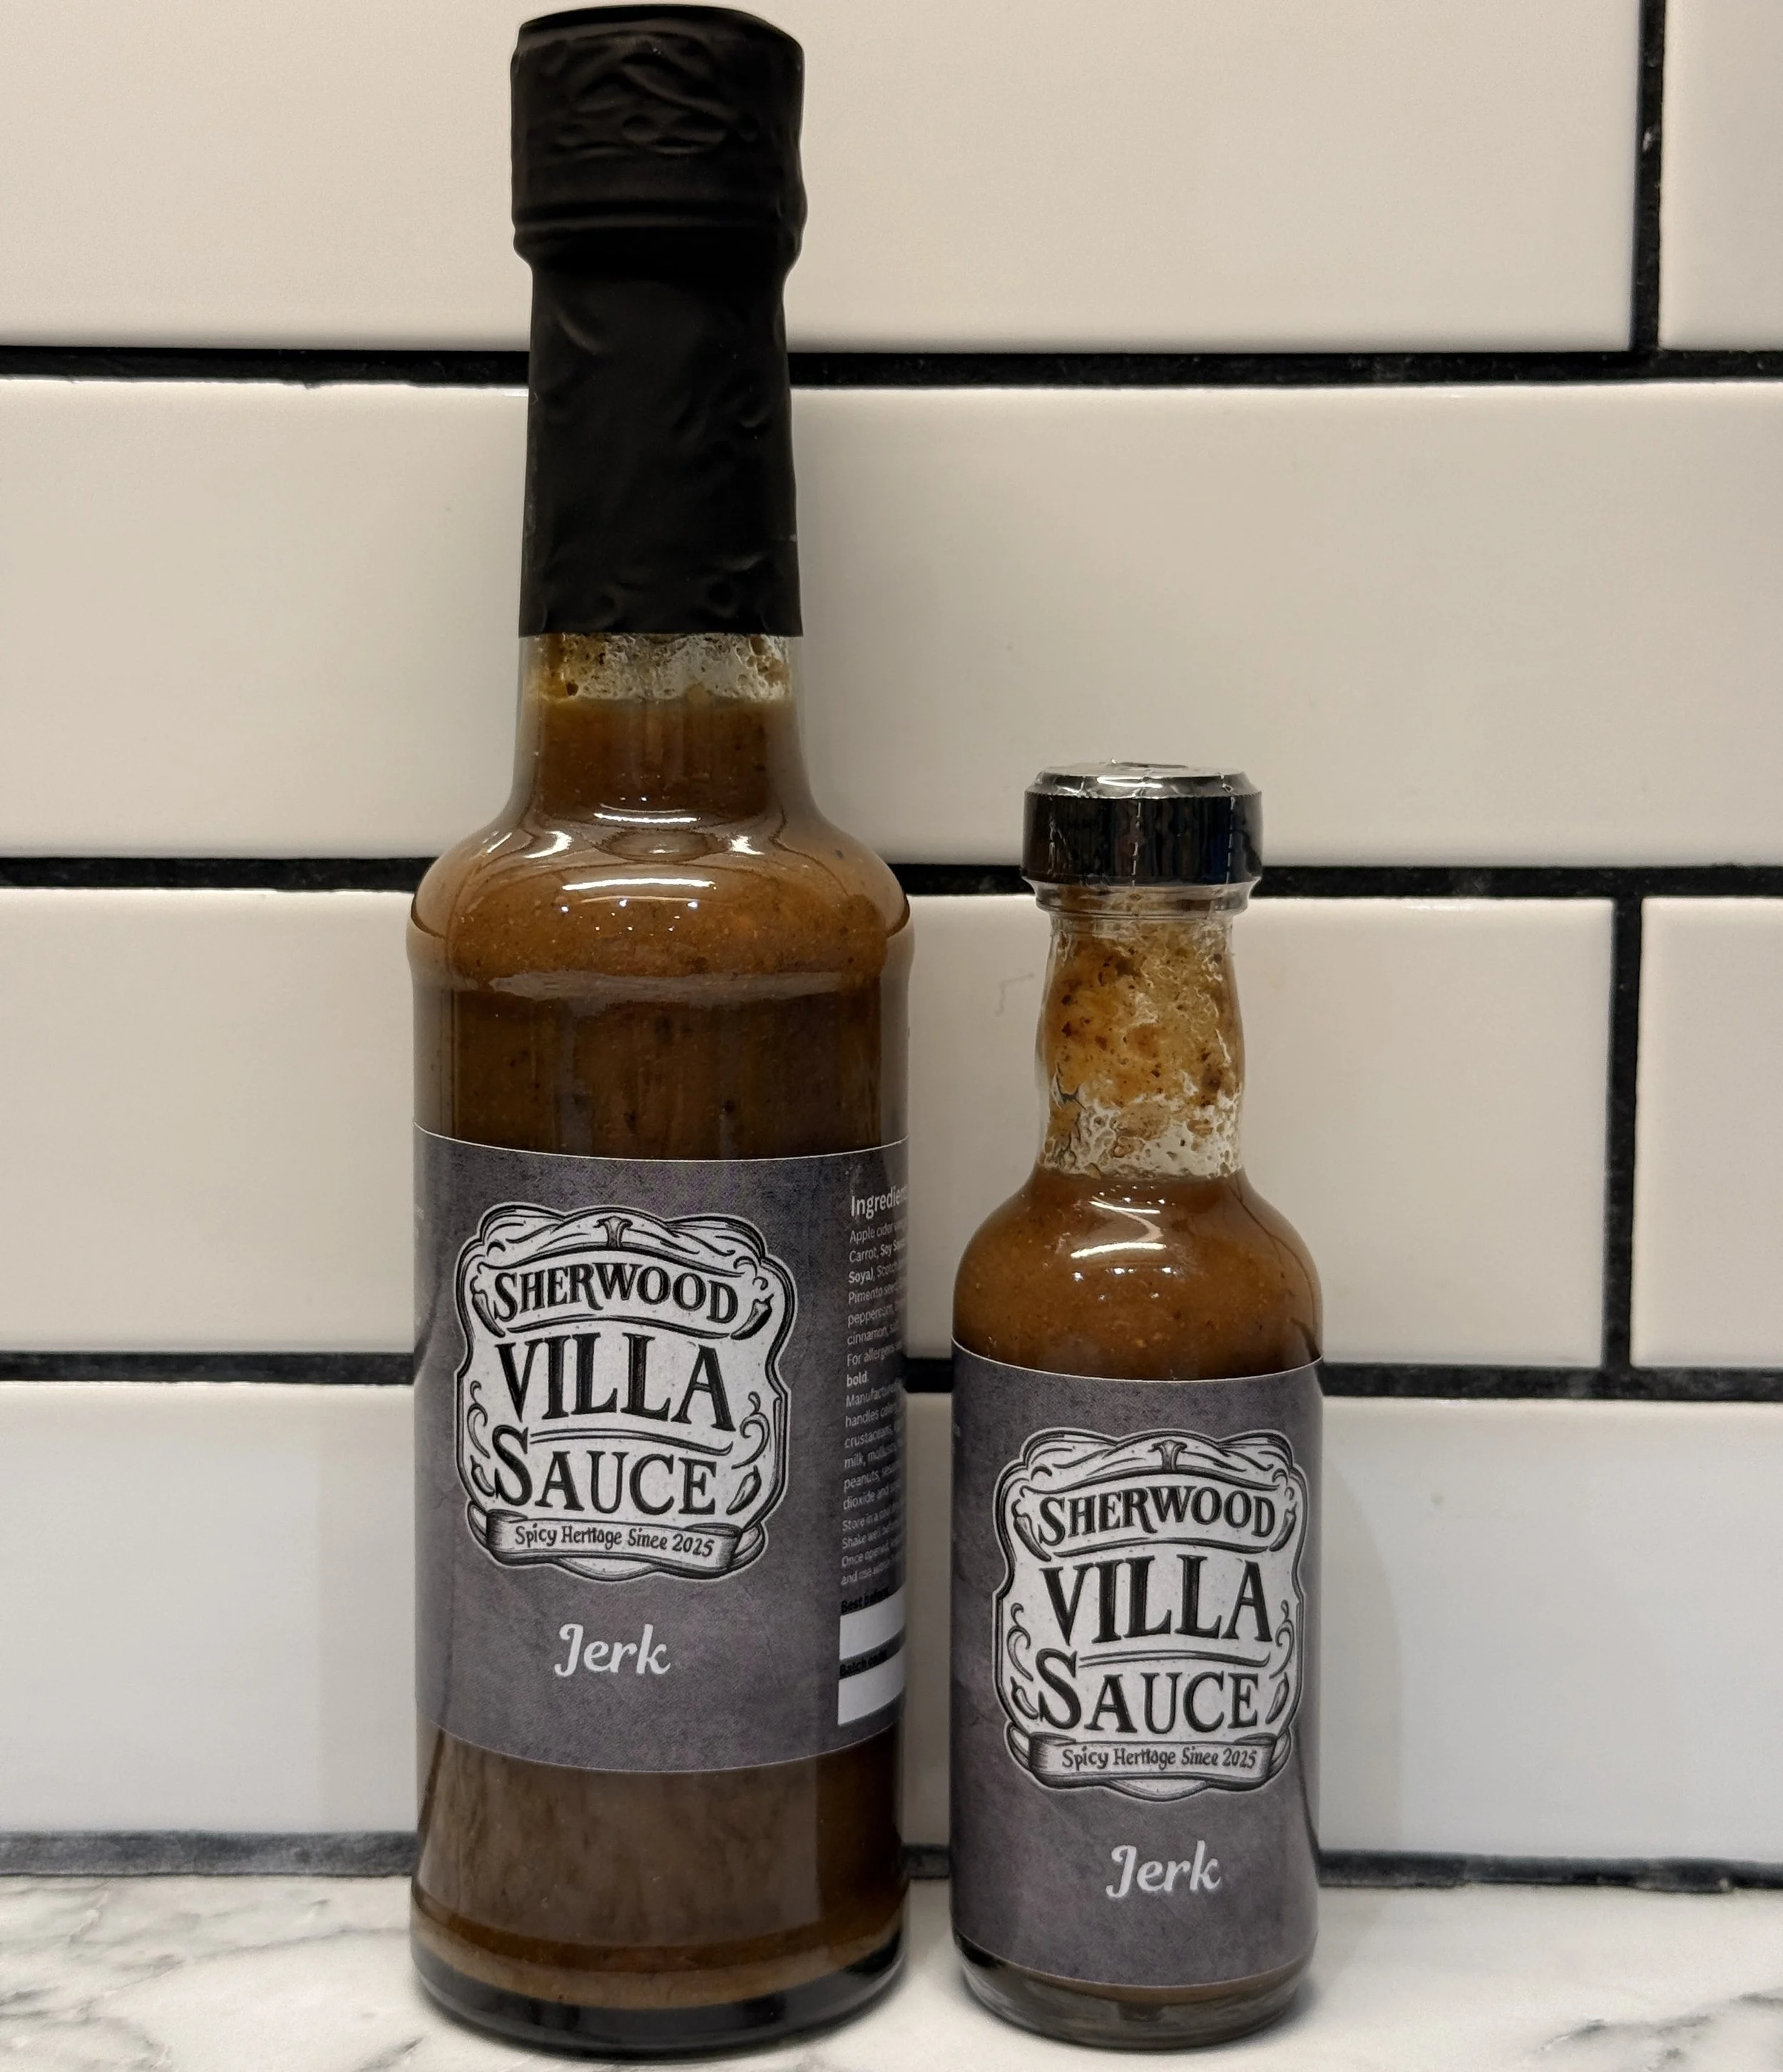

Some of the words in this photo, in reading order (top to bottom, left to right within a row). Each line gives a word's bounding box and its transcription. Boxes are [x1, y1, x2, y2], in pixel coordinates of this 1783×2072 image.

[849, 1226, 875, 1245] Apple
[849, 1246, 879, 1263] Carrot,
[880, 1243, 892, 1257] Soy
[494, 1262, 739, 1324] SHERWOOD
[848, 1287, 883, 1305] Pimento
[847, 1353, 862, 1367] For
[495, 1332, 736, 1432] VILLA
[844, 1409, 879, 1428] handles
[492, 1424, 717, 1515] SAUCE
[842, 1489, 876, 1511] dioxide
[842, 1517, 864, 1533] Store
[1038, 1486, 1275, 1546] SHERWOOD
[515, 1523, 557, 1548] Spicy
[672, 1533, 715, 1557] 2025
[842, 1533, 867, 1551] Shake
[841, 1552, 864, 1568] Once
[840, 1571, 858, 1587] and
[1039, 1555, 1272, 1645] VILLA
[554, 1623, 671, 1677] Jerk
[1036, 1648, 1259, 1735] SAUCE
[1062, 1746, 1108, 1771] Spicy
[1222, 1747, 1257, 1769] 2025
[1105, 1840, 1221, 1897] Jerk
